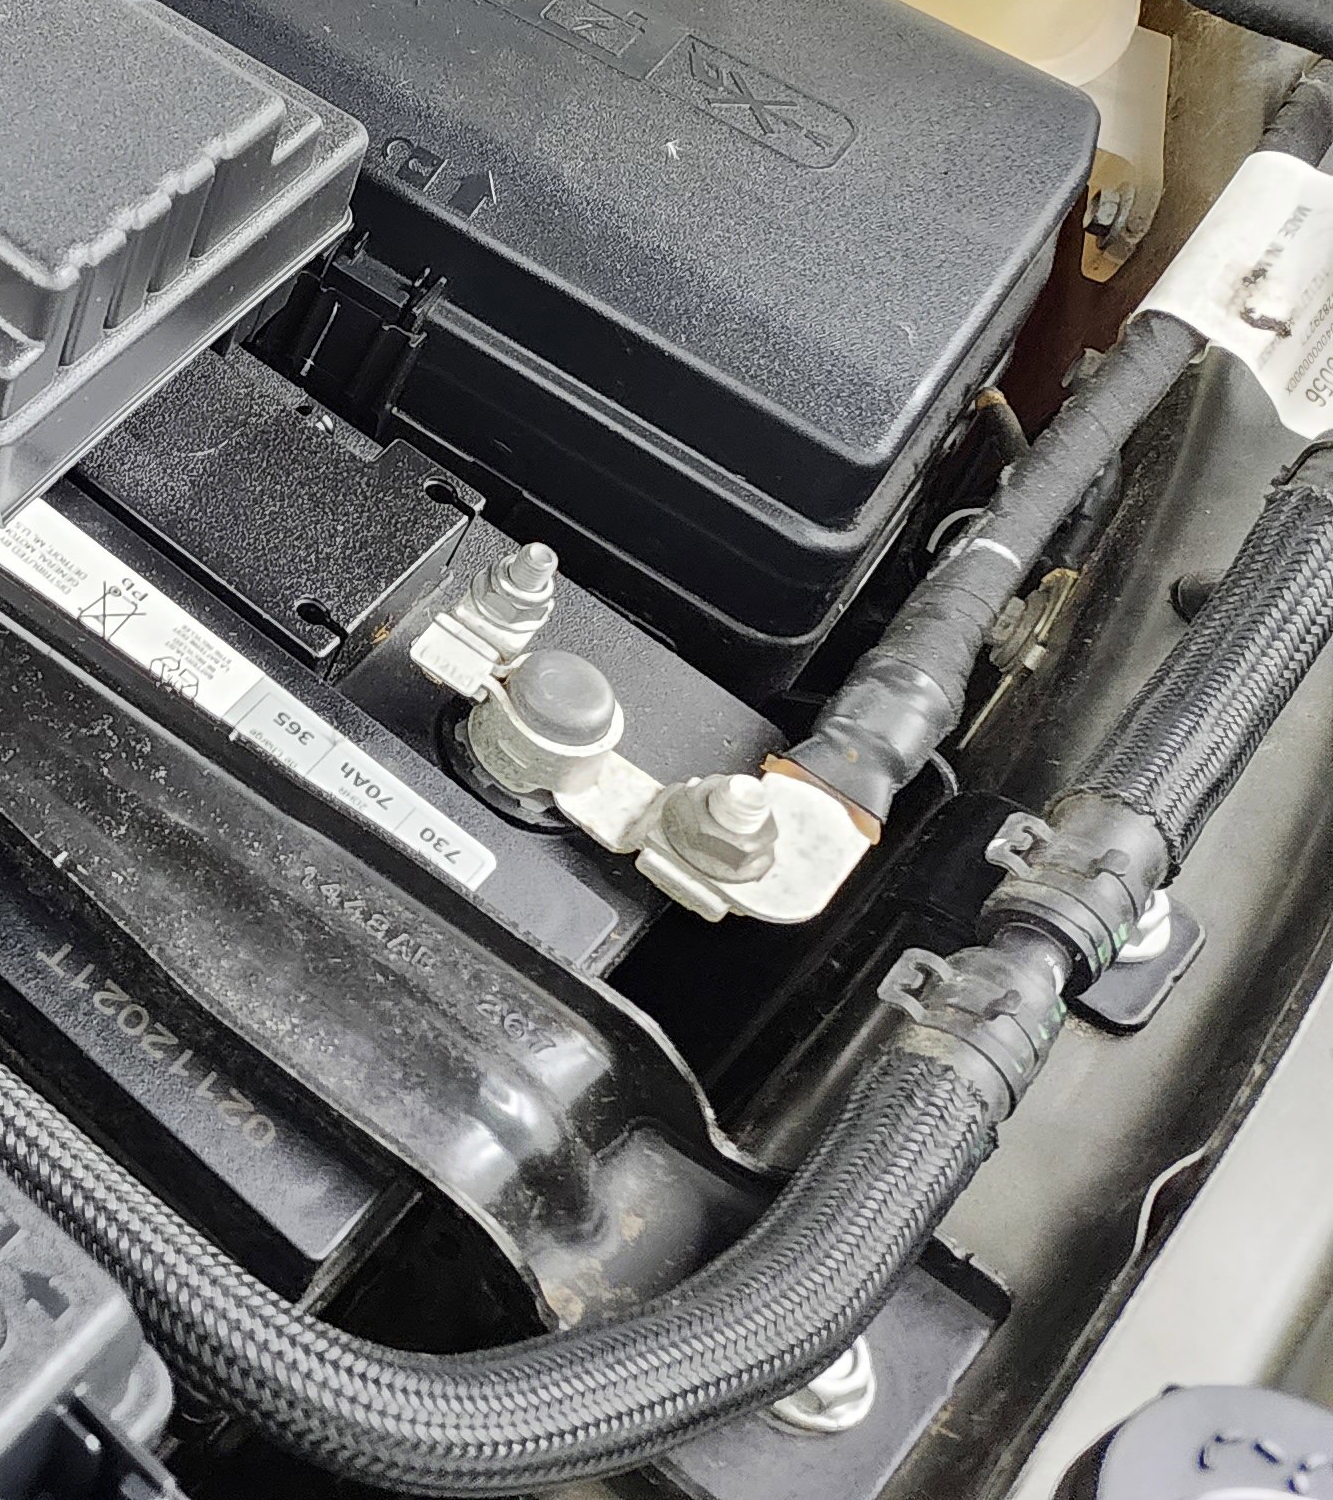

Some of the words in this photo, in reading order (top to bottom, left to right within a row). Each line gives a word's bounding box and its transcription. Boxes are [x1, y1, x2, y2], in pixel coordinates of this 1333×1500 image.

[13, 545, 74, 596] DISTRIBUTED
[36, 550, 81, 588] GENERAL
[120, 577, 149, 602] Pb
[273, 711, 315, 746] 365
[340, 761, 394, 811] 70Ah
[419, 827, 462, 865] 730
[36, 943, 277, 1149] 02112021T
